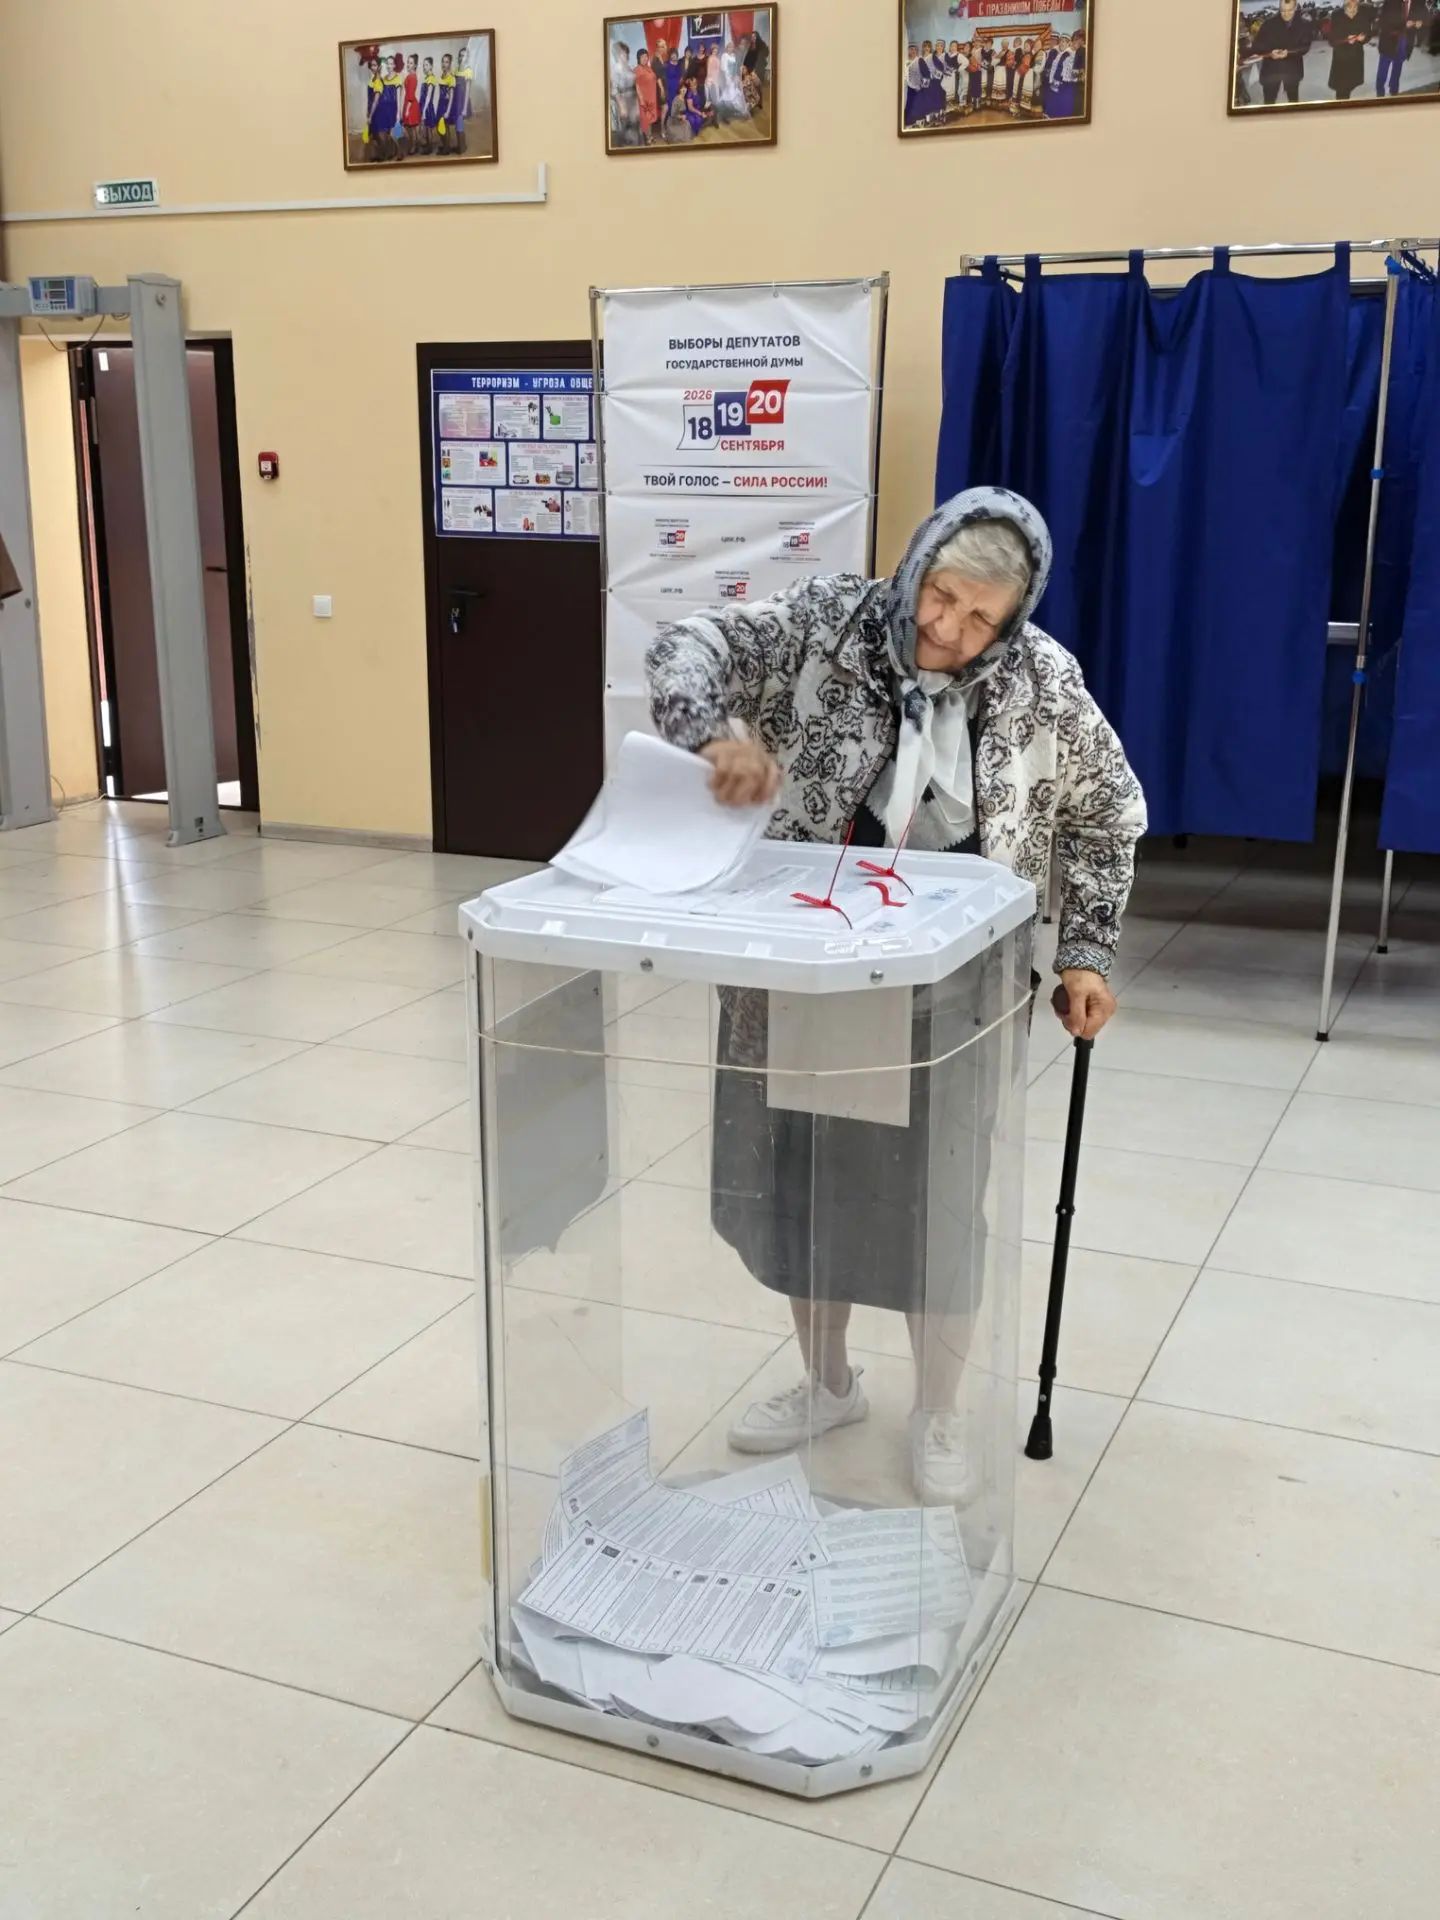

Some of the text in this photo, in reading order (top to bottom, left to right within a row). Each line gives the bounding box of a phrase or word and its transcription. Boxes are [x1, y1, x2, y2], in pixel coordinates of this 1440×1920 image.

[668, 336, 801, 350] ВЫБОРЫ ДЕПУТАТОВ
[665, 357, 804, 370] ГОСУДАРСТВЕННОЙ ДУМЫ
[471, 377, 520, 389] ТЕРРОРИЗМ
[532, 377, 565, 388] УГРОЗА
[683, 390, 713, 400] 2026
[688, 390, 782, 440] 18 19 20
[720, 440, 785, 451] СЕНТЯБРЯ
[643, 473, 676, 486] ТВОЙ
[679, 475, 719, 487] ГОЛОС
[733, 477, 767, 488] СИЛА
[770, 477, 828, 488] РОССИИ!
